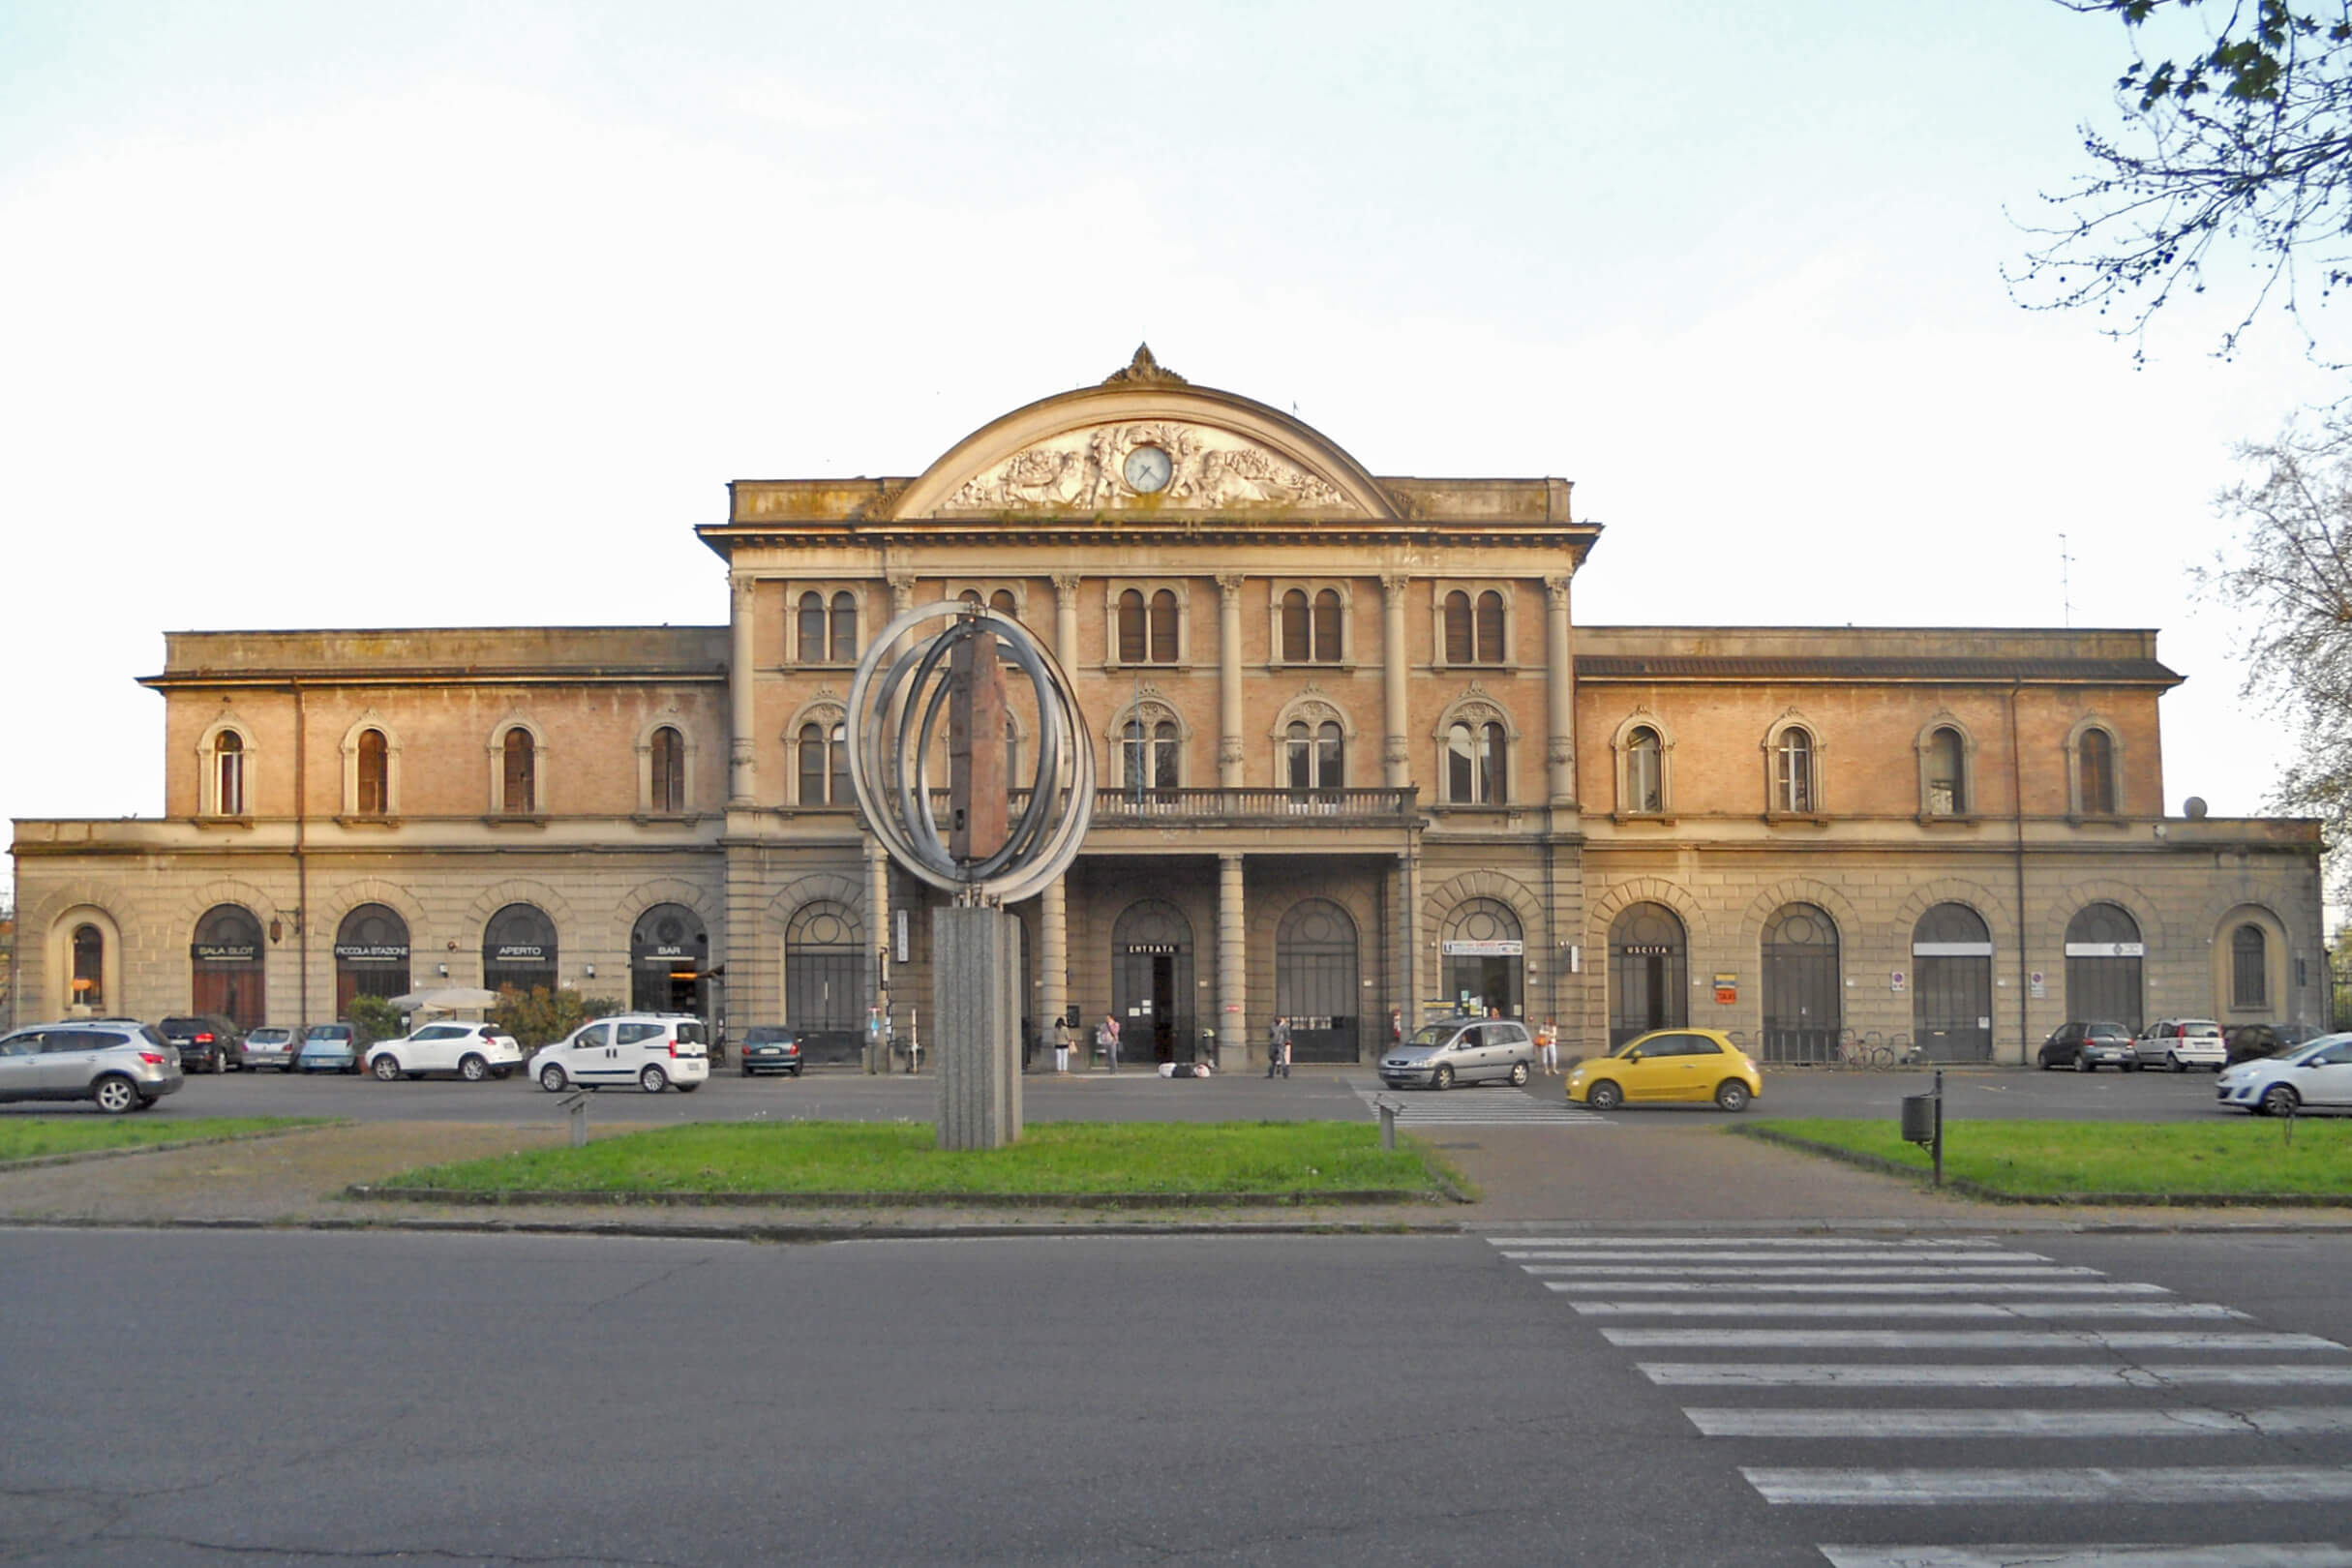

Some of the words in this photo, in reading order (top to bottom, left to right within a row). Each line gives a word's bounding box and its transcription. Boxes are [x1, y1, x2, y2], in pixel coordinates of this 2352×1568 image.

[498, 946, 542, 955] APERTO
[657, 946, 681, 955] BAR
[1129, 945, 1174, 953] ENTRATA
